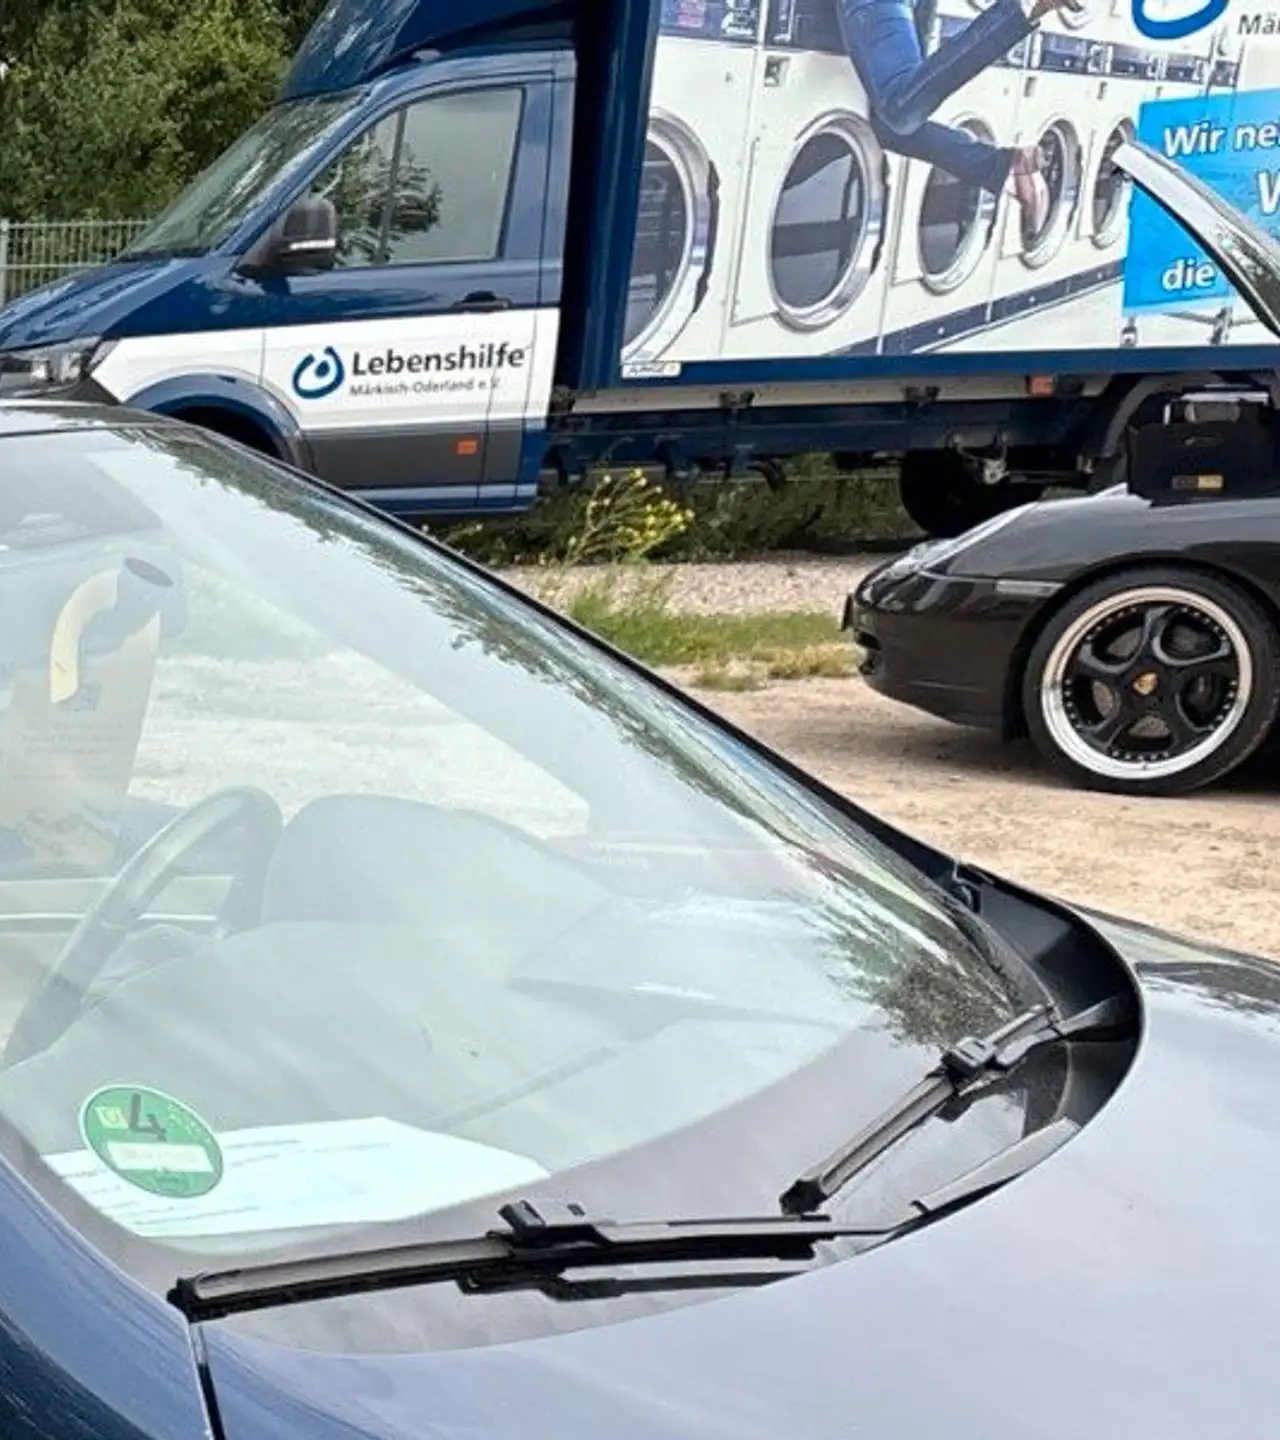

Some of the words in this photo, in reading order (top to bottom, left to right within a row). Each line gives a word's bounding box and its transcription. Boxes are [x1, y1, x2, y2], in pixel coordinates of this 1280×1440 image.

[1164, 120, 1225, 157] Wir
[1162, 258, 1216, 290] die
[352, 341, 525, 376] Lebenshilfe
